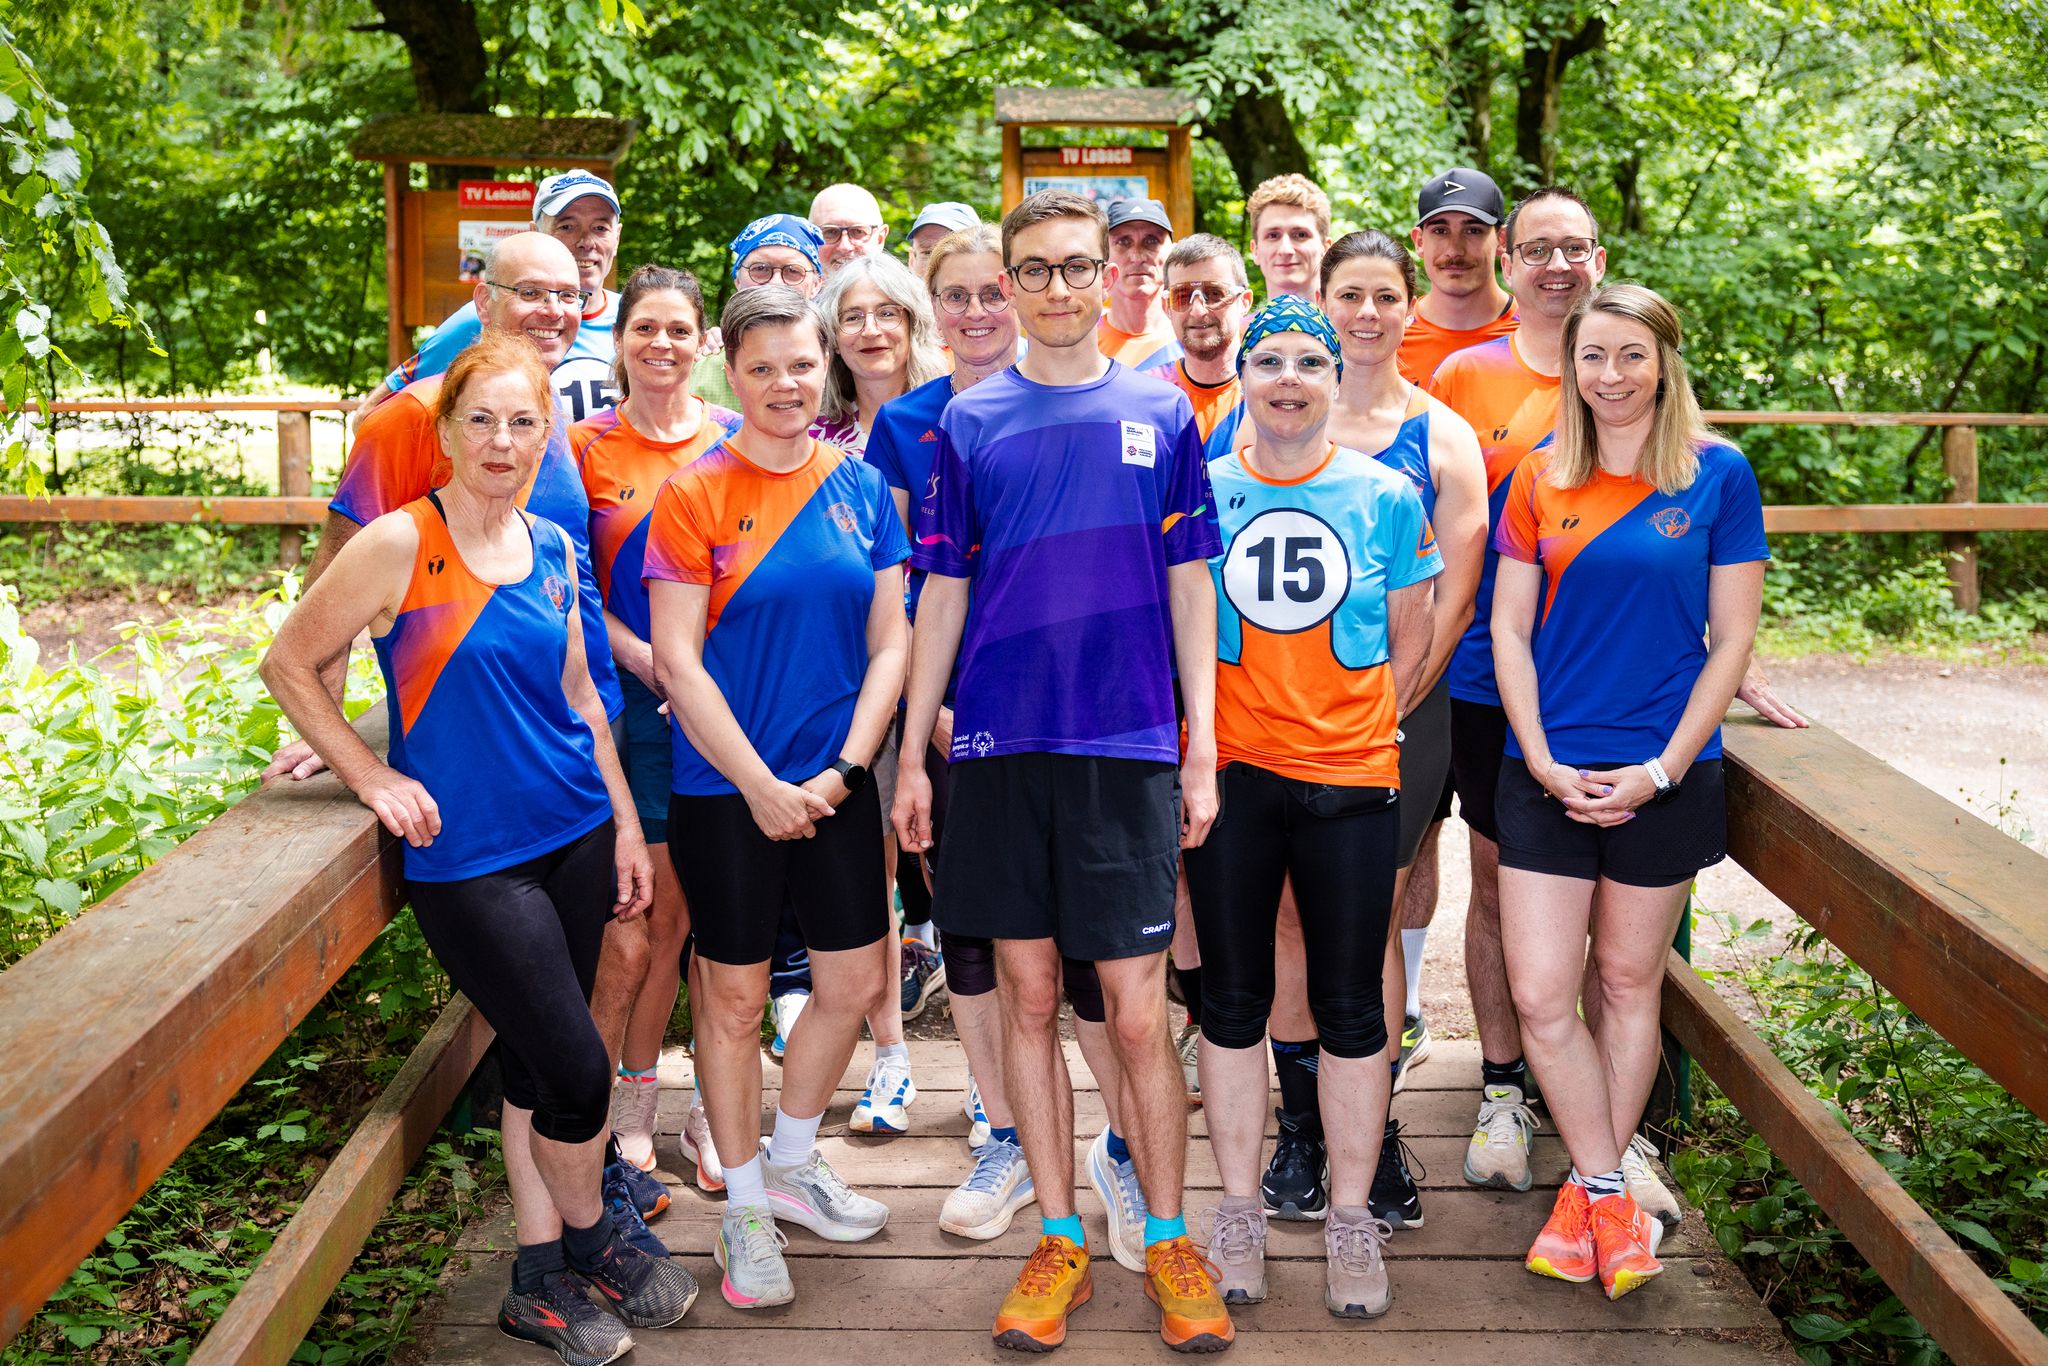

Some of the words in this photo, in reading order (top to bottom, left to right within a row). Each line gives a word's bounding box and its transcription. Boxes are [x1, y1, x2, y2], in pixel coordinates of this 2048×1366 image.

[1062, 148, 1079, 164] TV
[1082, 148, 1132, 164] Lebach
[464, 187, 483, 201] TV
[485, 187, 532, 201] Lebach
[560, 380, 618, 423] 15
[1246, 536, 1326, 603] 15
[1142, 922, 1168, 935] CRAFT
[811, 1183, 833, 1203] BROOKS
